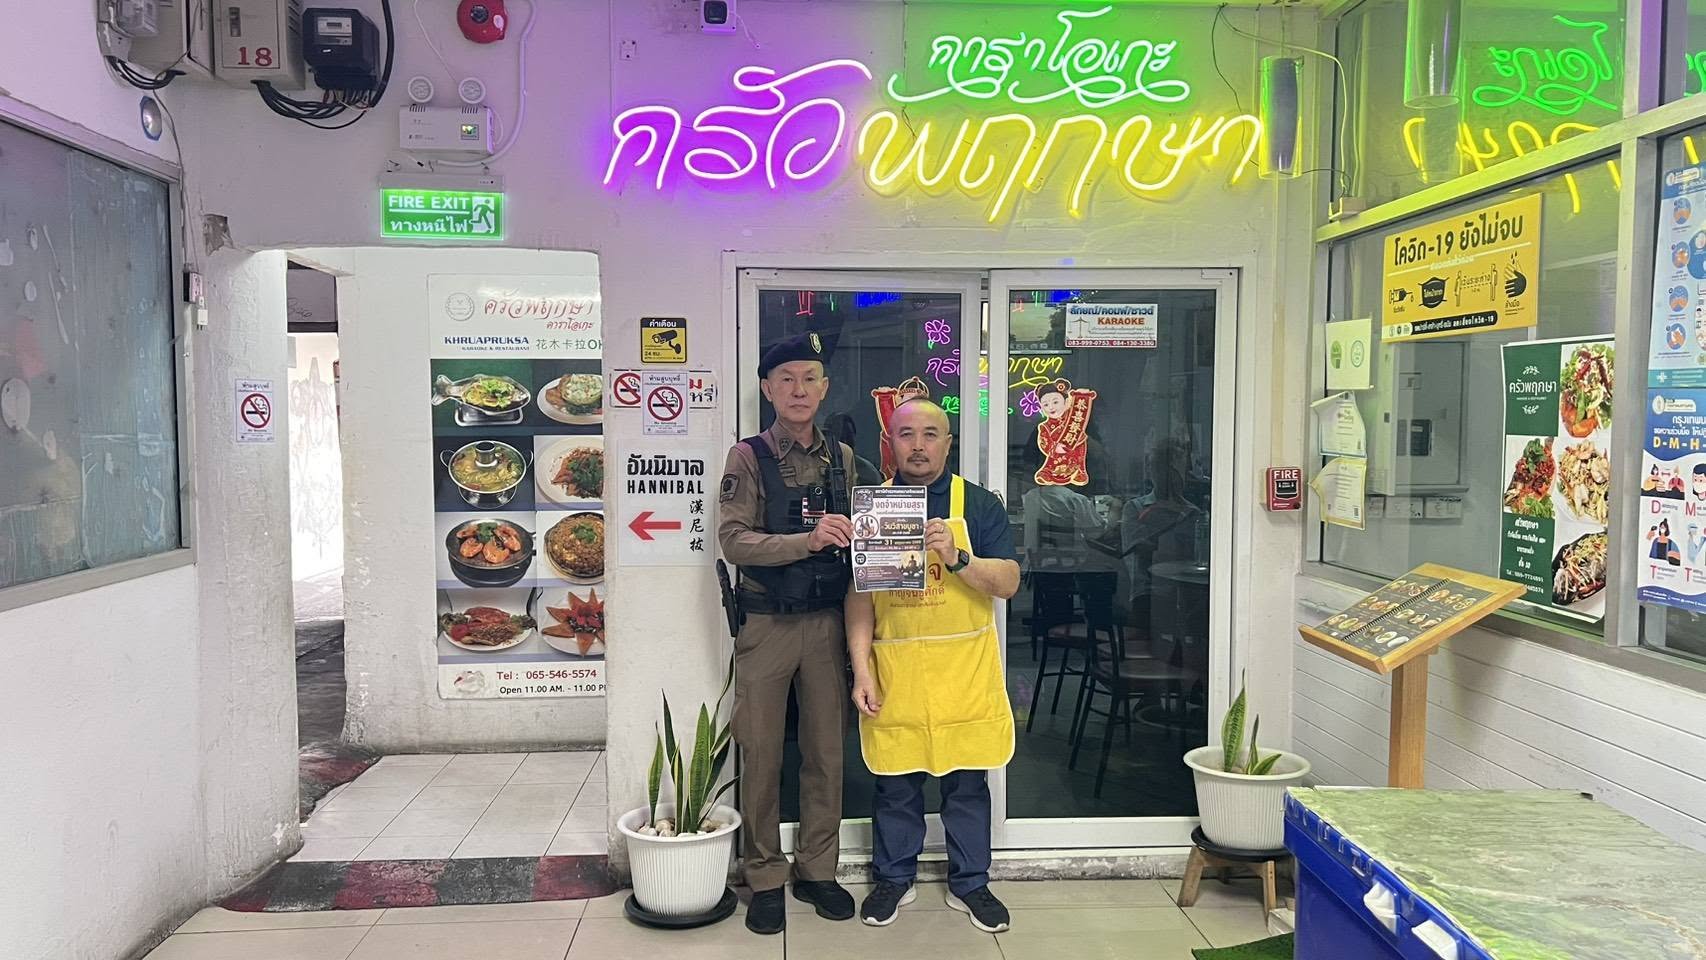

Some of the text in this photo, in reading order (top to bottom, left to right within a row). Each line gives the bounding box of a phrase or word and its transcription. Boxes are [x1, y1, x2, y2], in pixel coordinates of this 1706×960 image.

[237, 46, 273, 66] 18
[888, 6, 1190, 108] คาราโอเกะ
[388, 195, 470, 210] FIRE EXIT
[390, 215, 468, 232] ทางหนีไฟ
[1394, 230, 1454, 266] โควิด-19
[1459, 211, 1524, 251] ยังไม่จบ
[546, 317, 594, 332] คาราโอเกะ
[649, 319, 677, 328] คำเตือน
[1097, 317, 1145, 325] KARAOKE
[444, 336, 530, 345] KHRUAPRUKSA
[1509, 378, 1557, 396] ครัวพฤกษา
[1273, 470, 1299, 479] FIRE
[627, 480, 704, 494] HANNIBAL
[875, 500, 925, 511] งดจำหน่ายสุรา
[689, 498, 705, 552] 漢尼拔
[496, 671, 513, 680] Tel
[526, 669, 597, 680] 065-546-5574
[499, 686, 522, 695] Open
[549, 685, 565, 693] AM.
